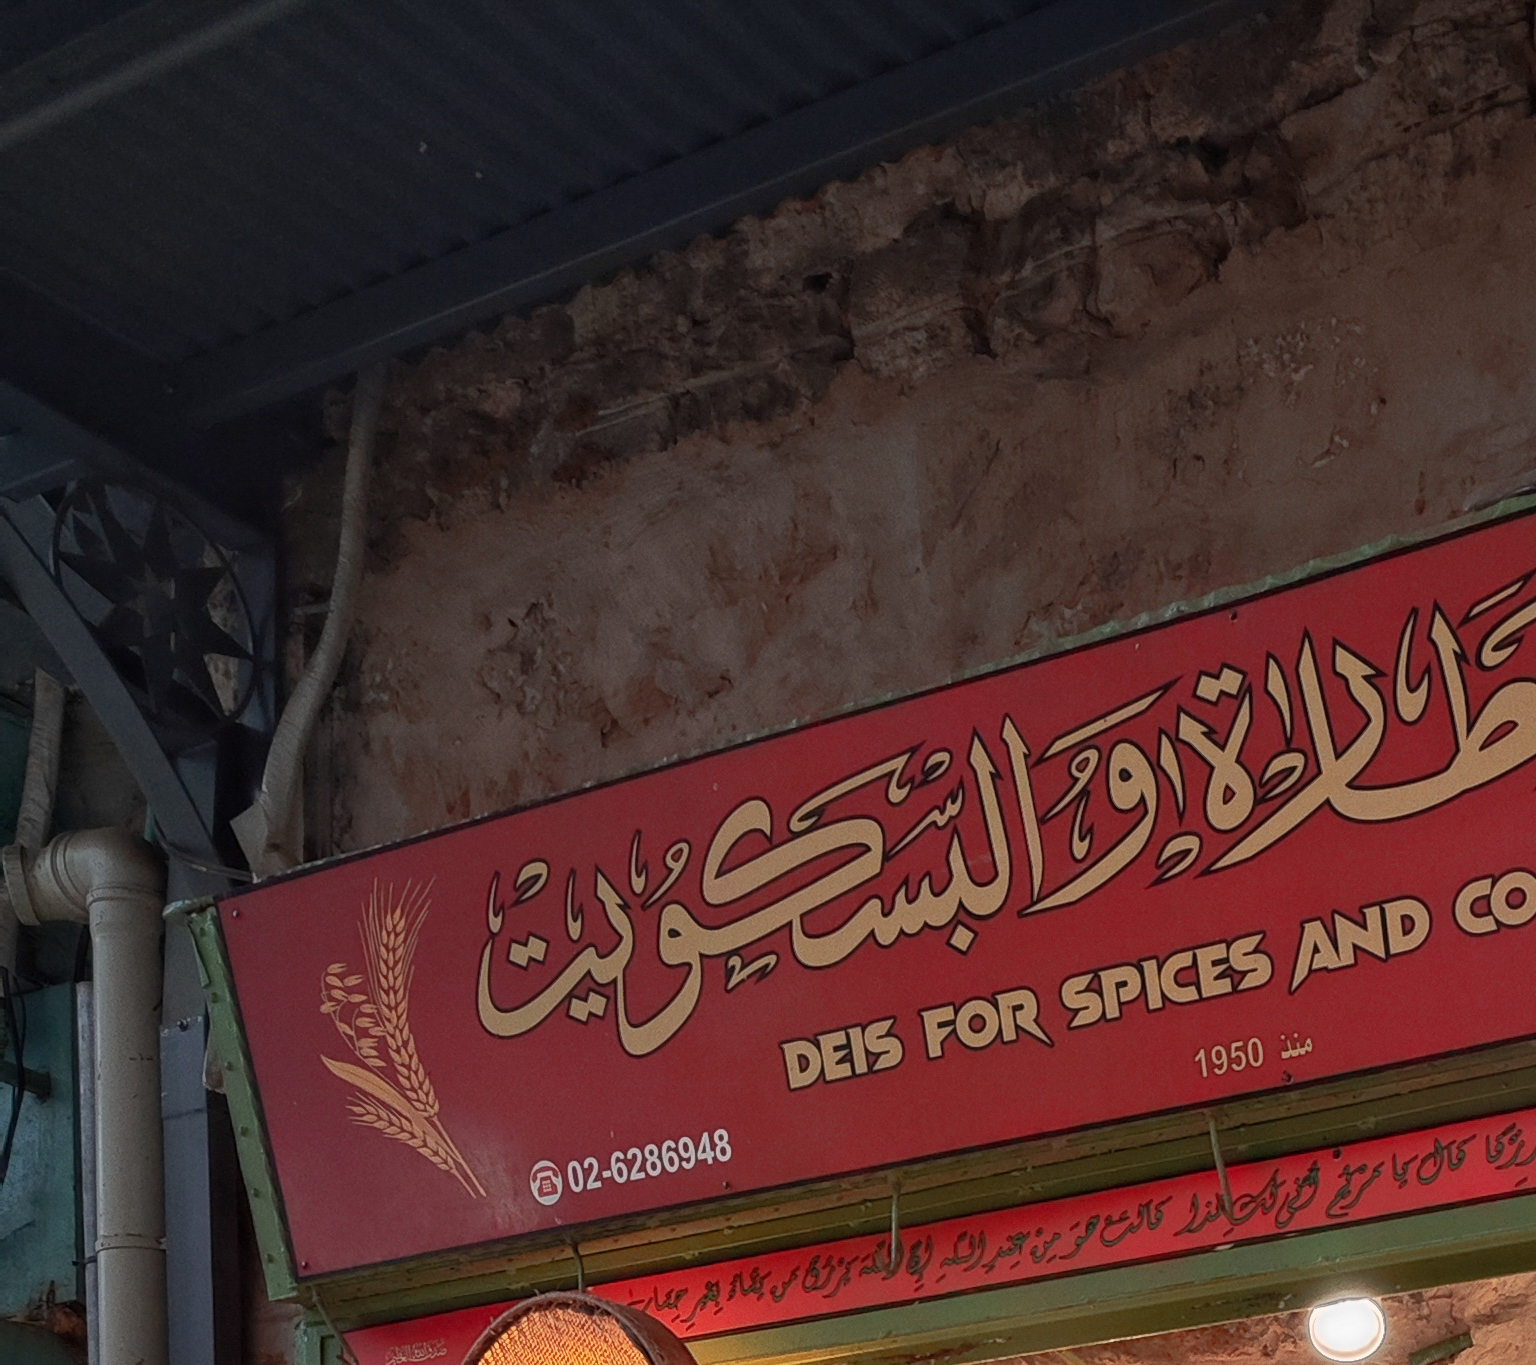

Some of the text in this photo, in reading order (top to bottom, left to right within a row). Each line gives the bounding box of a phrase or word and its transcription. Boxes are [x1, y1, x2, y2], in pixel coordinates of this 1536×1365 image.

[781, 1017, 903, 1091] DEIS
[921, 987, 1053, 1061] FOR
[1060, 932, 1273, 1031] SPICES
[1290, 895, 1431, 994] AND
[1194, 1032, 1313, 1078] منذ 1950
[567, 1128, 733, 1194] 02-6286948
